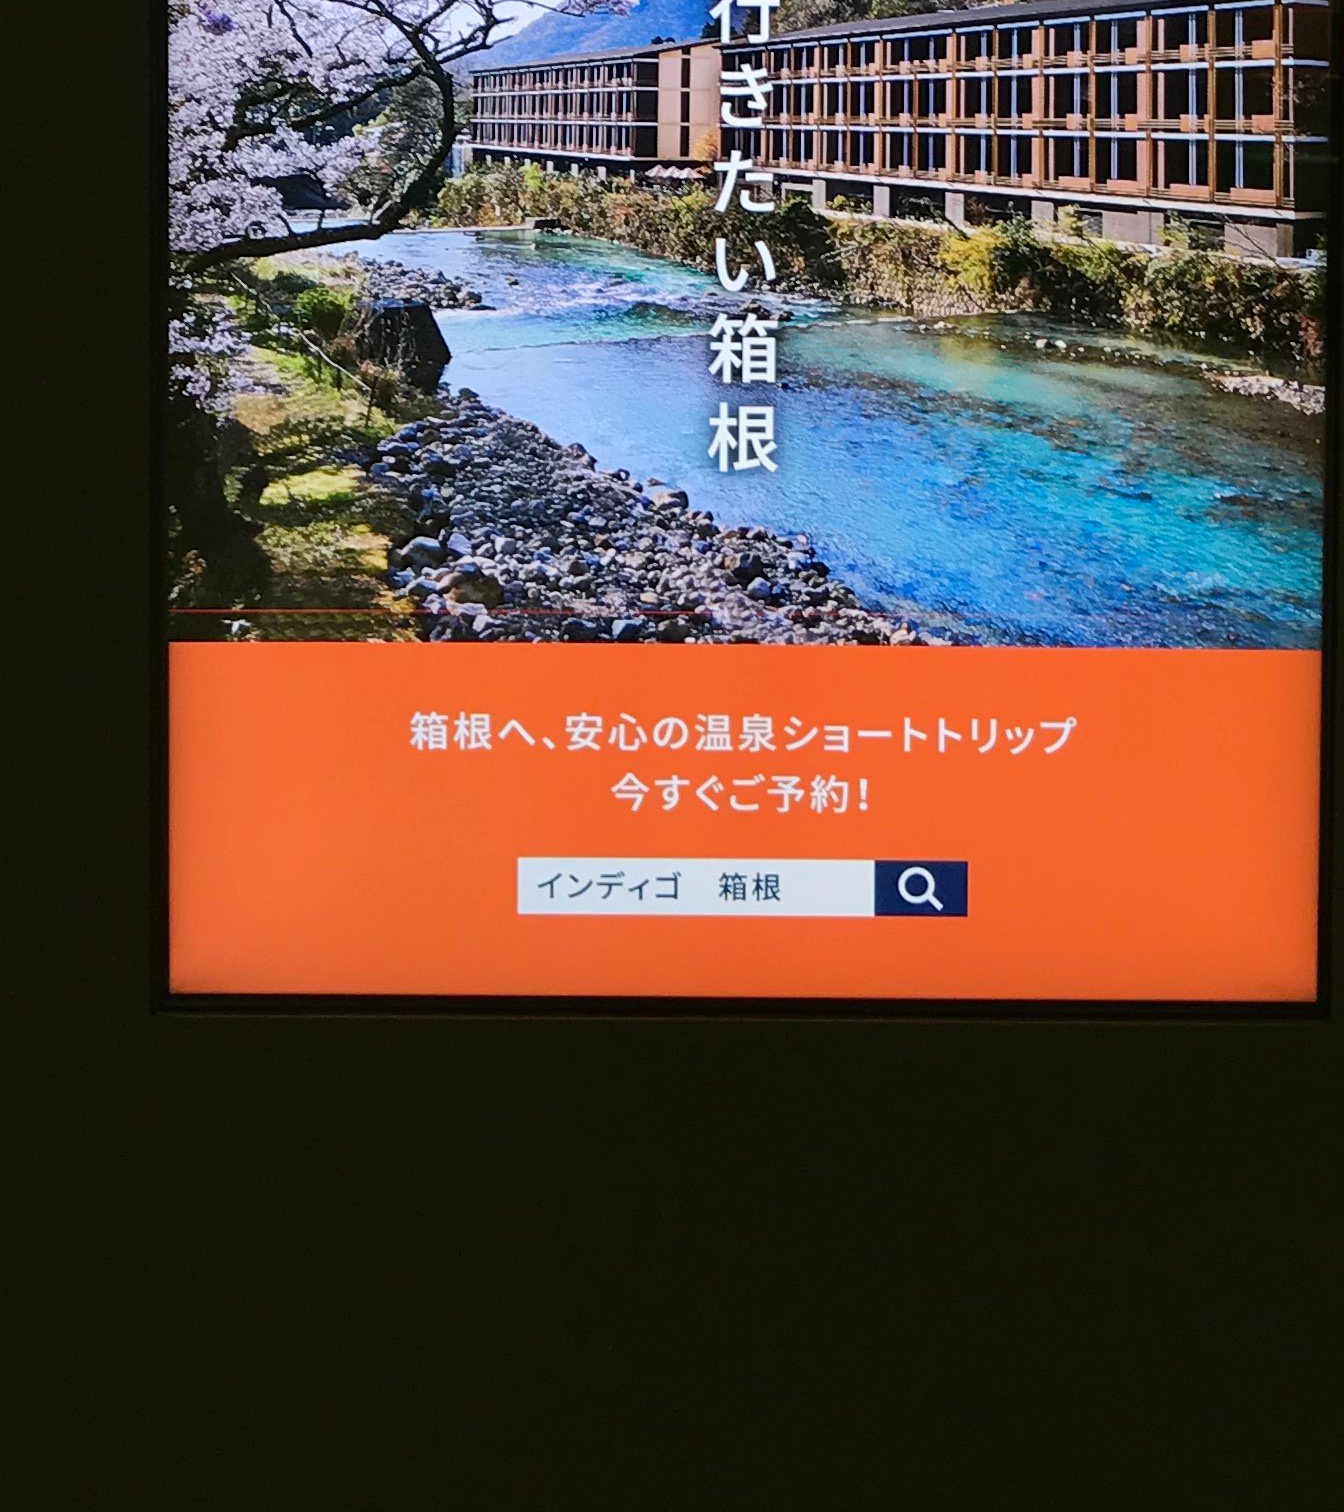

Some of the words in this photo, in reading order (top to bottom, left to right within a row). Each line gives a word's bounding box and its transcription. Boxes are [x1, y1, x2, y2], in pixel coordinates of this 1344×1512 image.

[409, 711, 1077, 755] 箱根へ、安心の温泉ショートトリップ
[610, 773, 870, 815] 今すぐご予約!
[536, 871, 682, 903] インディゴ
[718, 872, 782, 903] 箱根
